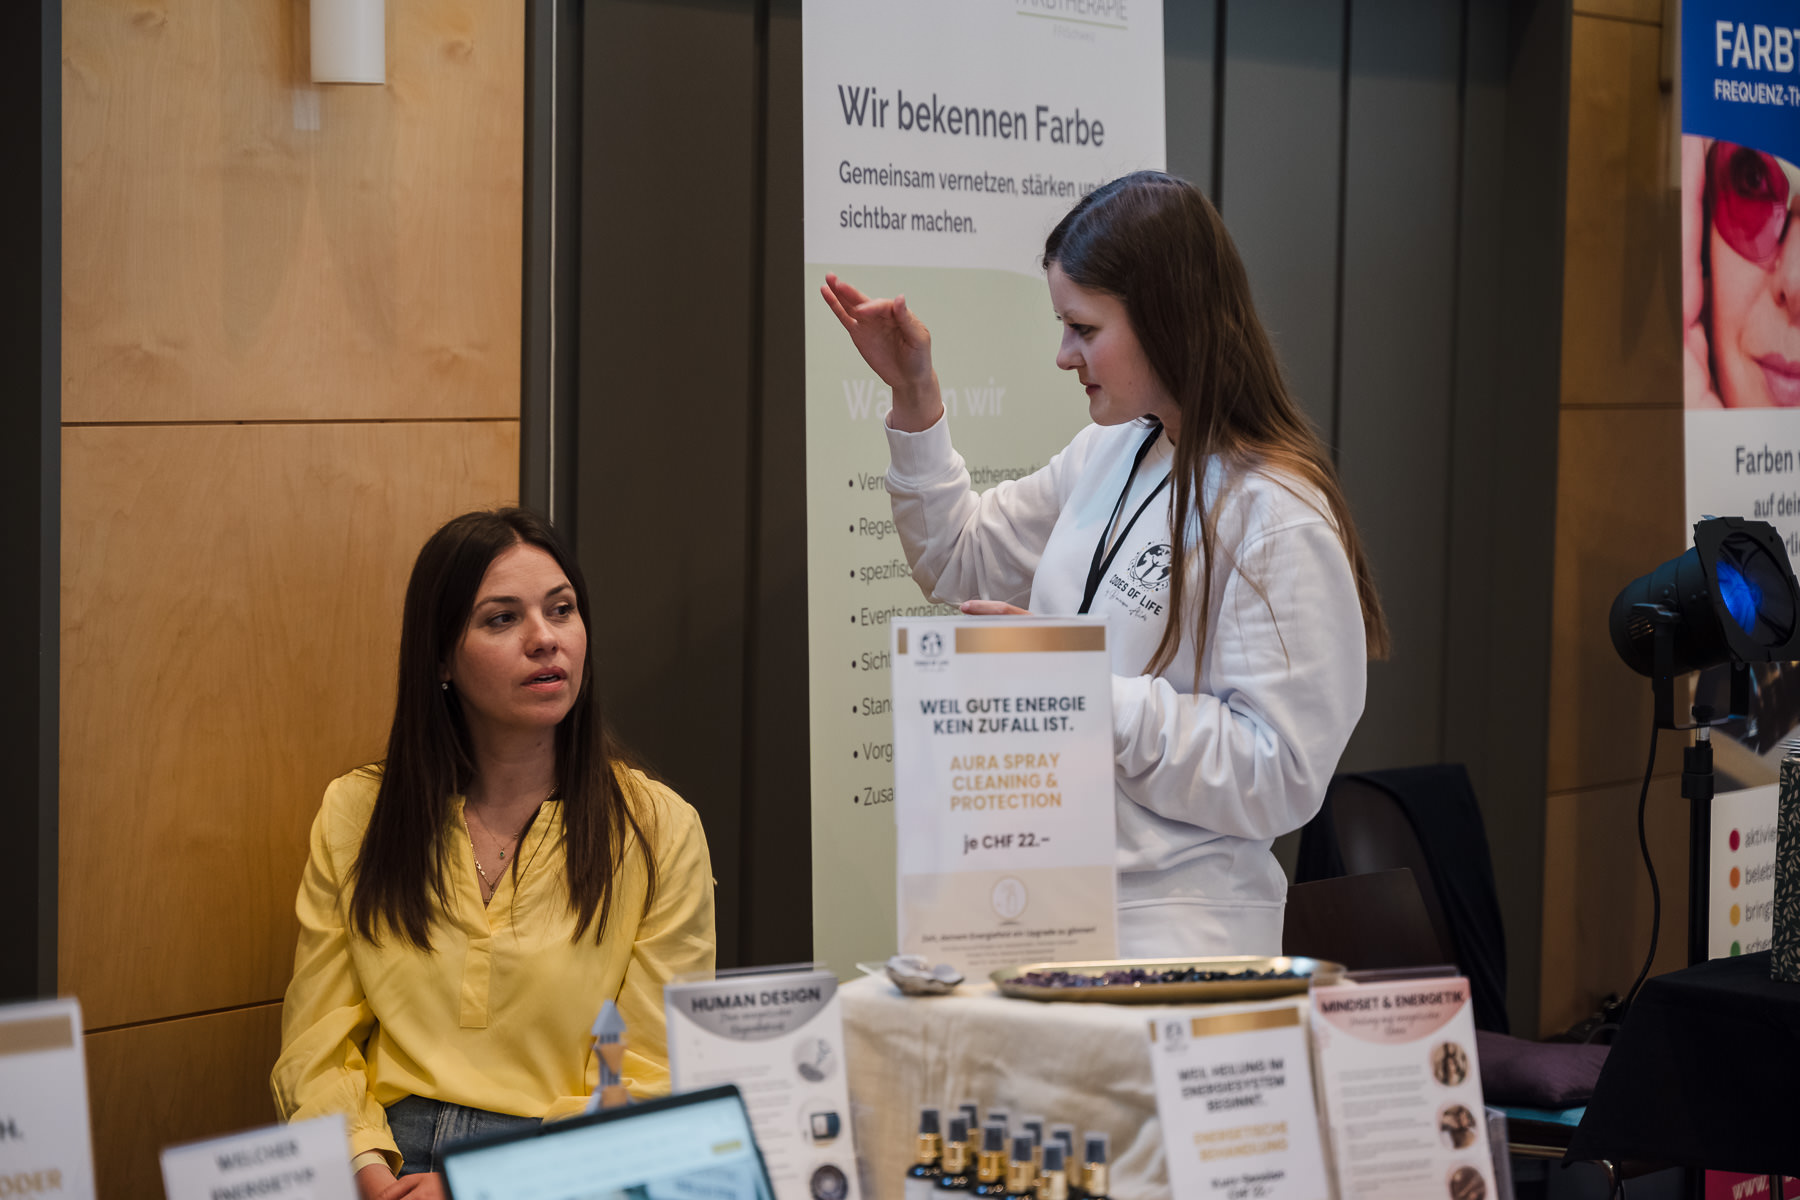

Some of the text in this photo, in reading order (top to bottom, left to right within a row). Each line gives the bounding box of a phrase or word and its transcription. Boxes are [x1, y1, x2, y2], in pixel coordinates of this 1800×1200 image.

[1015, 0, 1128, 21] ERAPIE
[837, 84, 1104, 147] Wir bekennen Farbe
[839, 160, 1105, 198] Gemeinsam vernetzen, stärken un
[839, 204, 977, 234] sichtbar machen.
[965, 376, 1006, 417] wir
[1735, 444, 1793, 474] Farben
[1754, 492, 1775, 518] auf
[1127, 587, 1141, 599] OF
[1140, 595, 1163, 616] LIFE
[860, 605, 902, 626] Events
[920, 696, 1086, 715] WEIL GUTE ENERGIE
[933, 716, 1075, 735] KEIN ZUFALL IST.
[862, 742, 893, 763] Vorg
[950, 753, 1060, 772] AURA SPRAY
[952, 773, 1058, 792] CLEANING &
[950, 793, 1063, 812] PROTECTION
[963, 834, 979, 855] je
[982, 834, 1014, 850] CHF
[691, 987, 821, 1013] HUMAN DESIGN
[1321, 990, 1464, 1014] MINDSET & ENERGETIK
